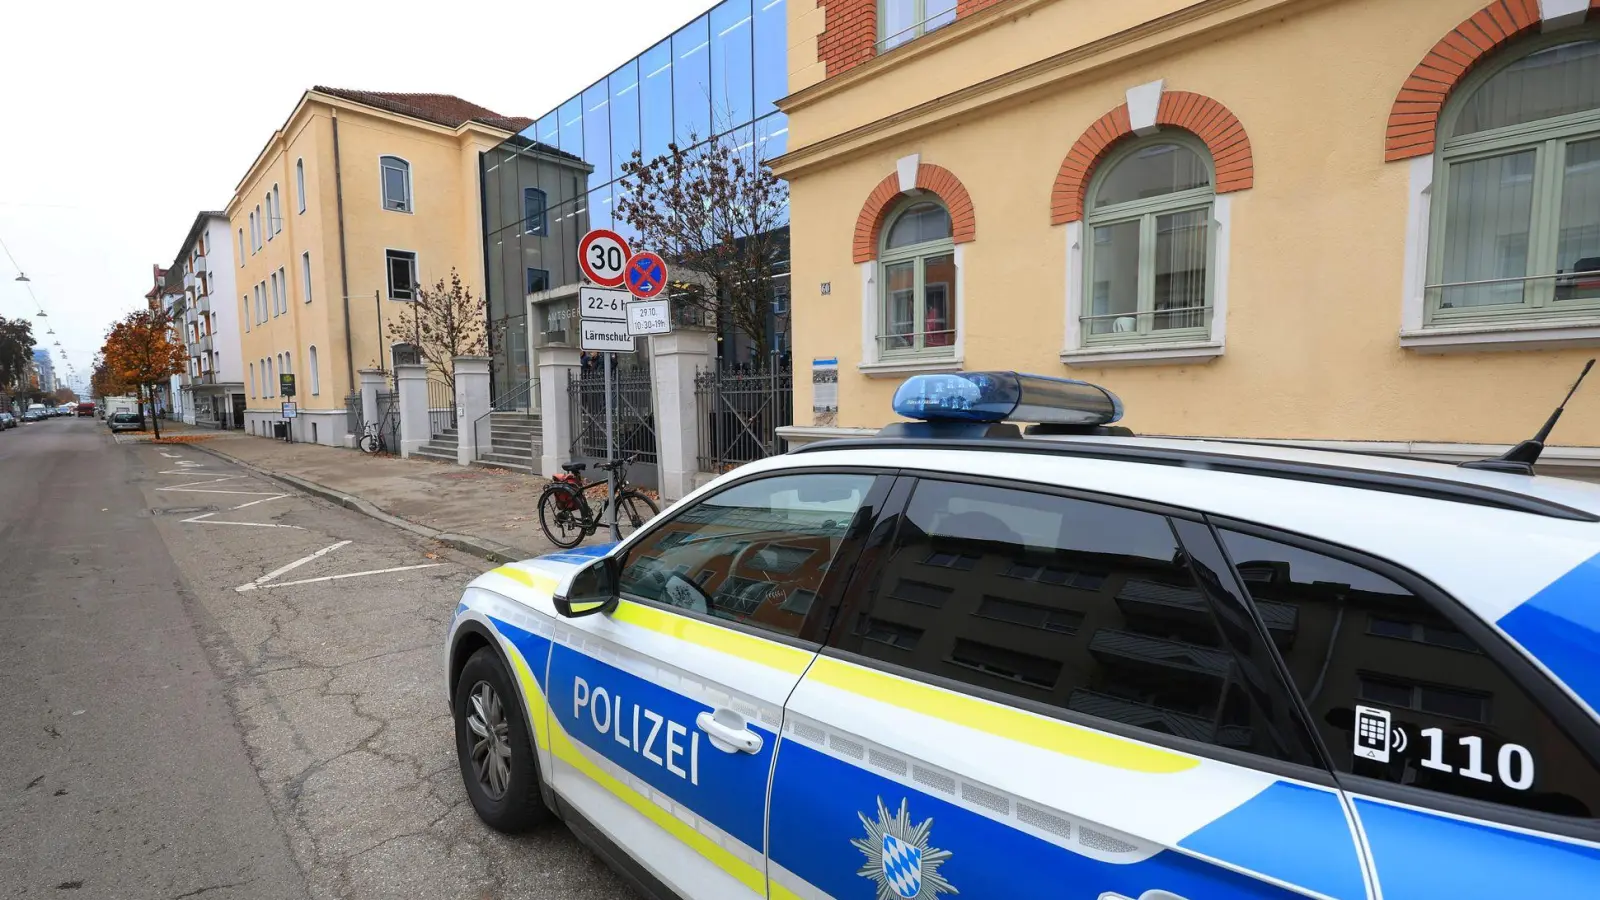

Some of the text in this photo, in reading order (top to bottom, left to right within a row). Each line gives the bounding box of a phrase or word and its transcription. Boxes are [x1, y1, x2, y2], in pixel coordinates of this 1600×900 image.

[591, 245, 621, 271] 30
[588, 297, 617, 311] 22-6
[548, 308, 580, 321] AMTSGER
[640, 308, 657, 317] 29.10.
[585, 330, 631, 342] Lärmschutz
[574, 676, 699, 785] POLIZEI
[1421, 727, 1535, 791] 110
